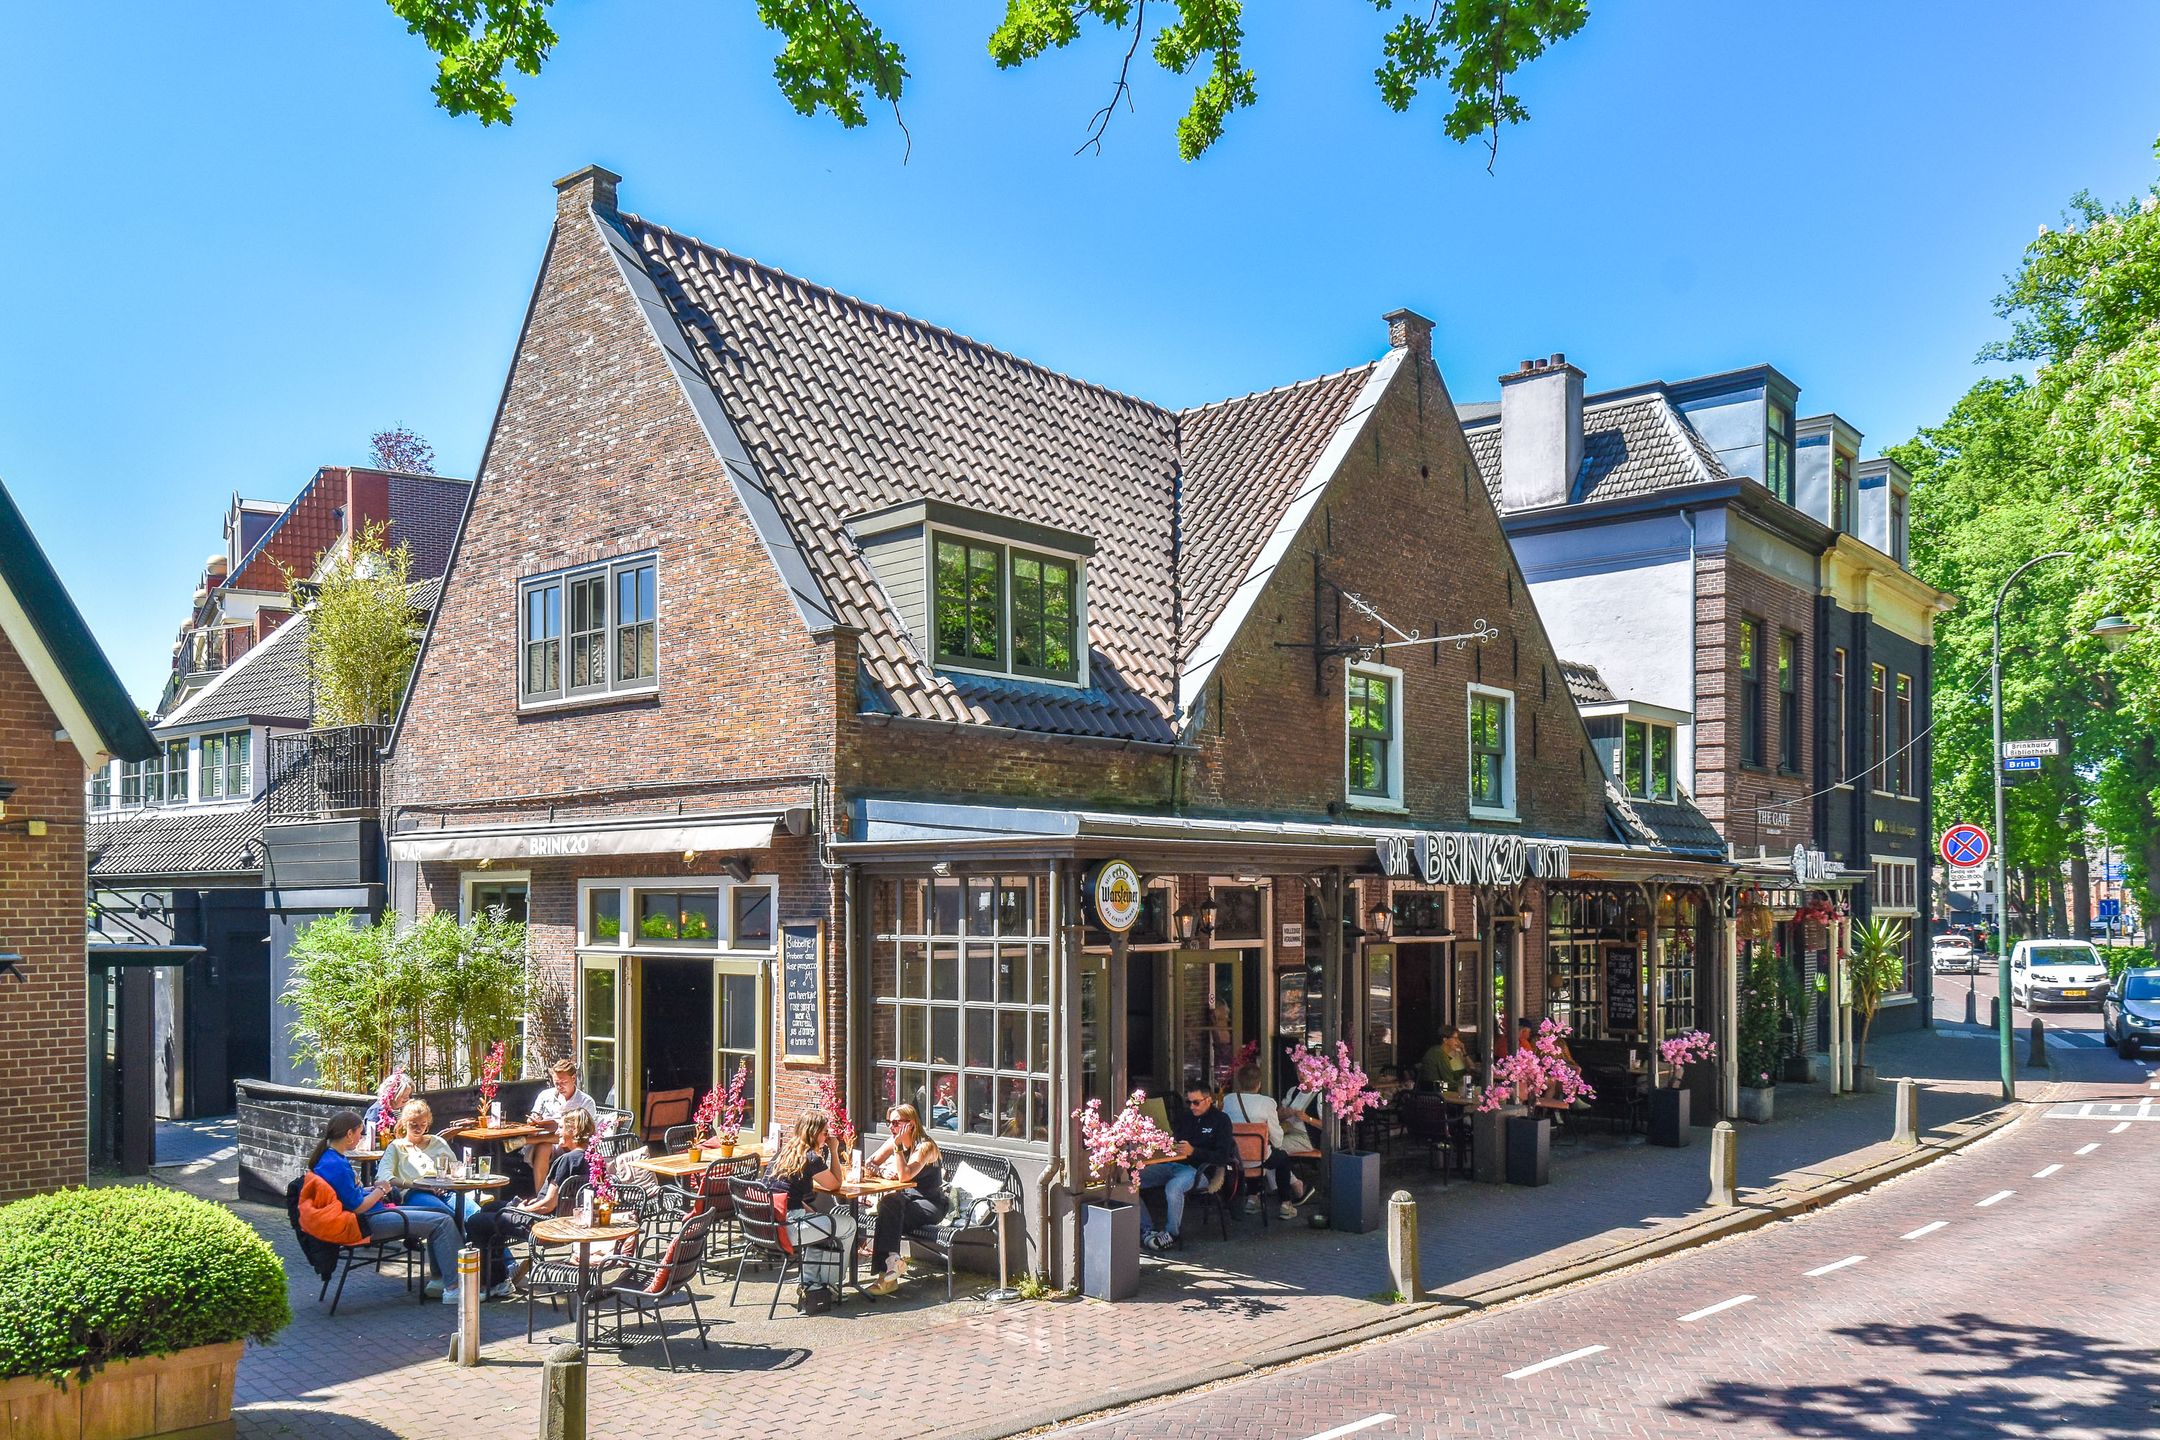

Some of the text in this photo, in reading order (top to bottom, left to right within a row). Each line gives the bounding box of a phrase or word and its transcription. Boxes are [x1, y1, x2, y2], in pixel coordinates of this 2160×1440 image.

[1757, 810, 1791, 826] THE GATE
[529, 836, 589, 856] BRINK20
[1387, 831, 1569, 886] BAR BRINK20 BISTRO
[1806, 850, 1825, 879] RON
[1101, 885, 1138, 904] Warsteiner
[790, 979, 797, 988] of
